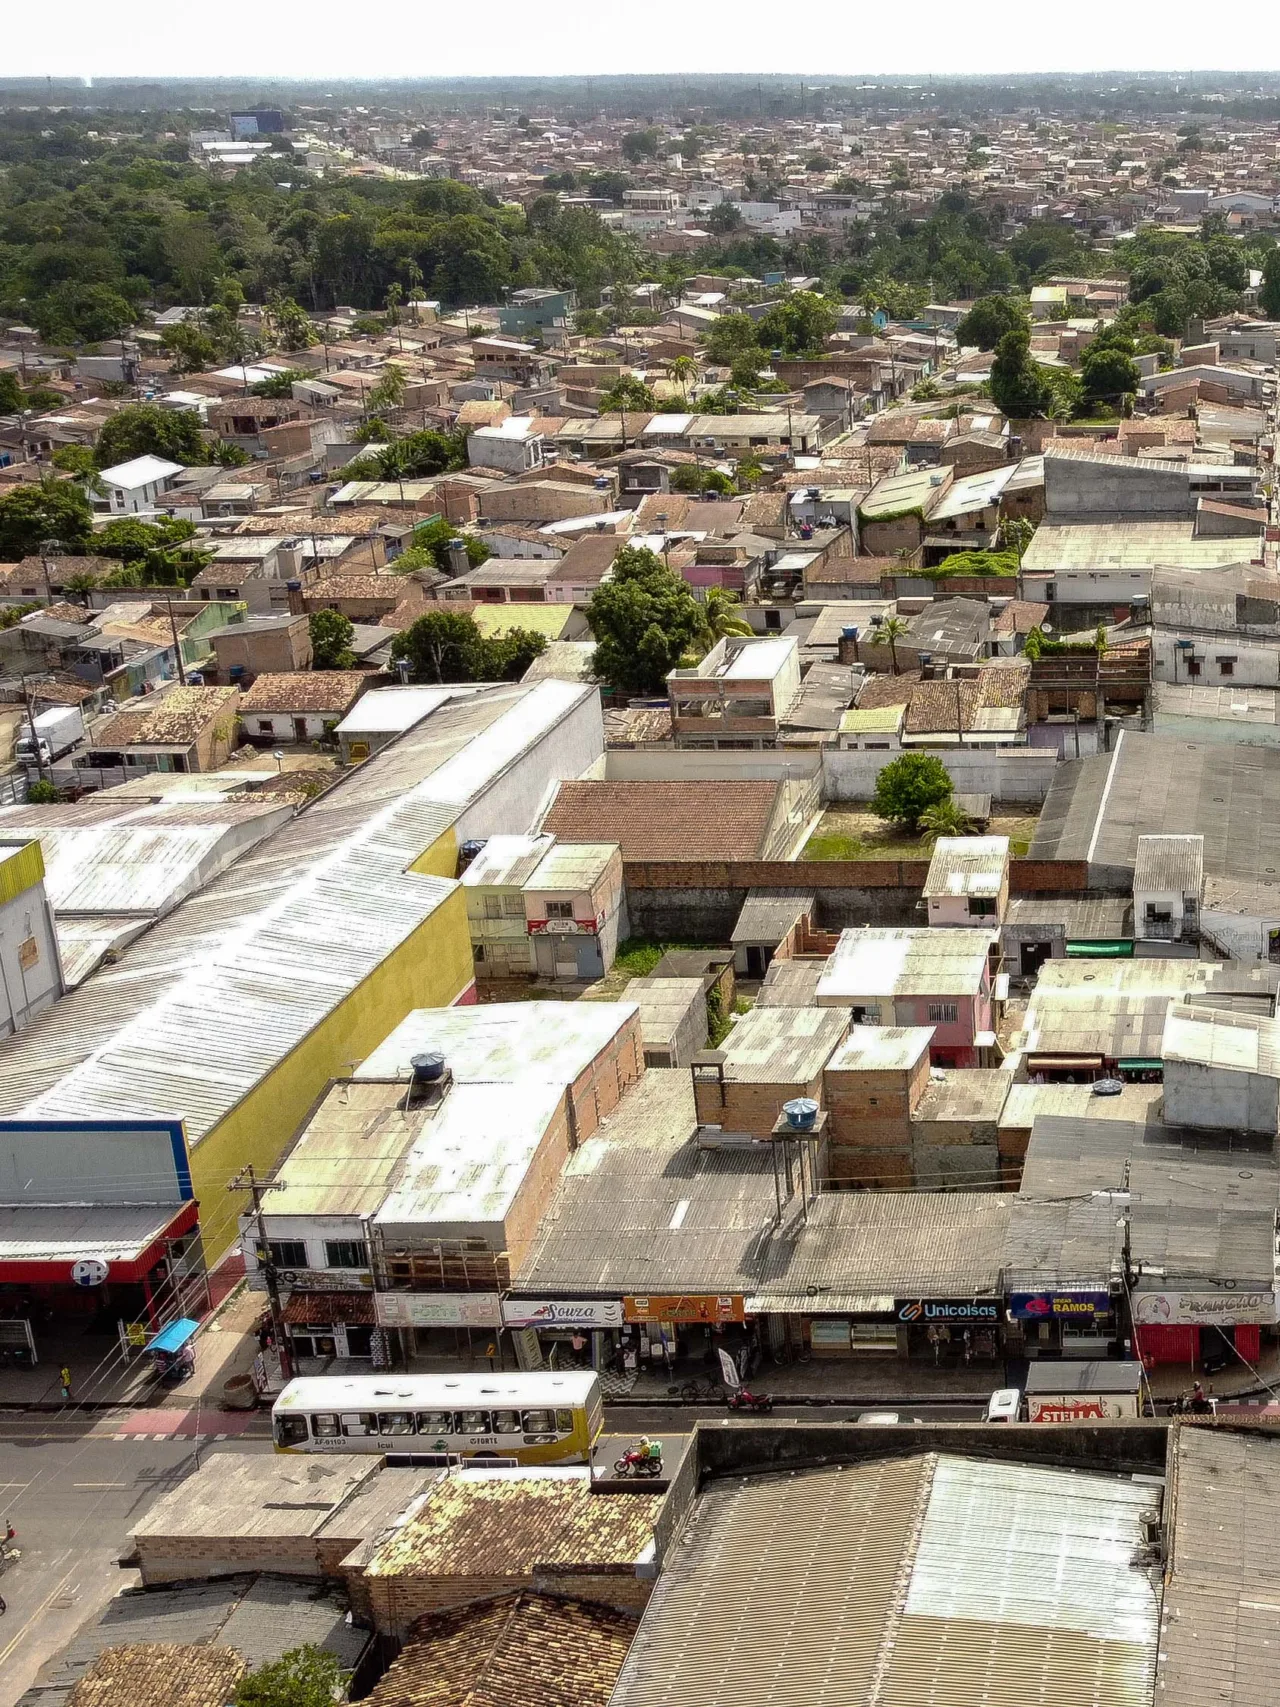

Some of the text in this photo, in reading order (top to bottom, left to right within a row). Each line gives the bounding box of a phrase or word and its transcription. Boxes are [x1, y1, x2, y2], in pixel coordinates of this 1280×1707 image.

[545, 1303, 596, 1320] Souza
[924, 1304, 997, 1317] Unicoisas
[1053, 1303, 1095, 1312] RAMOS
